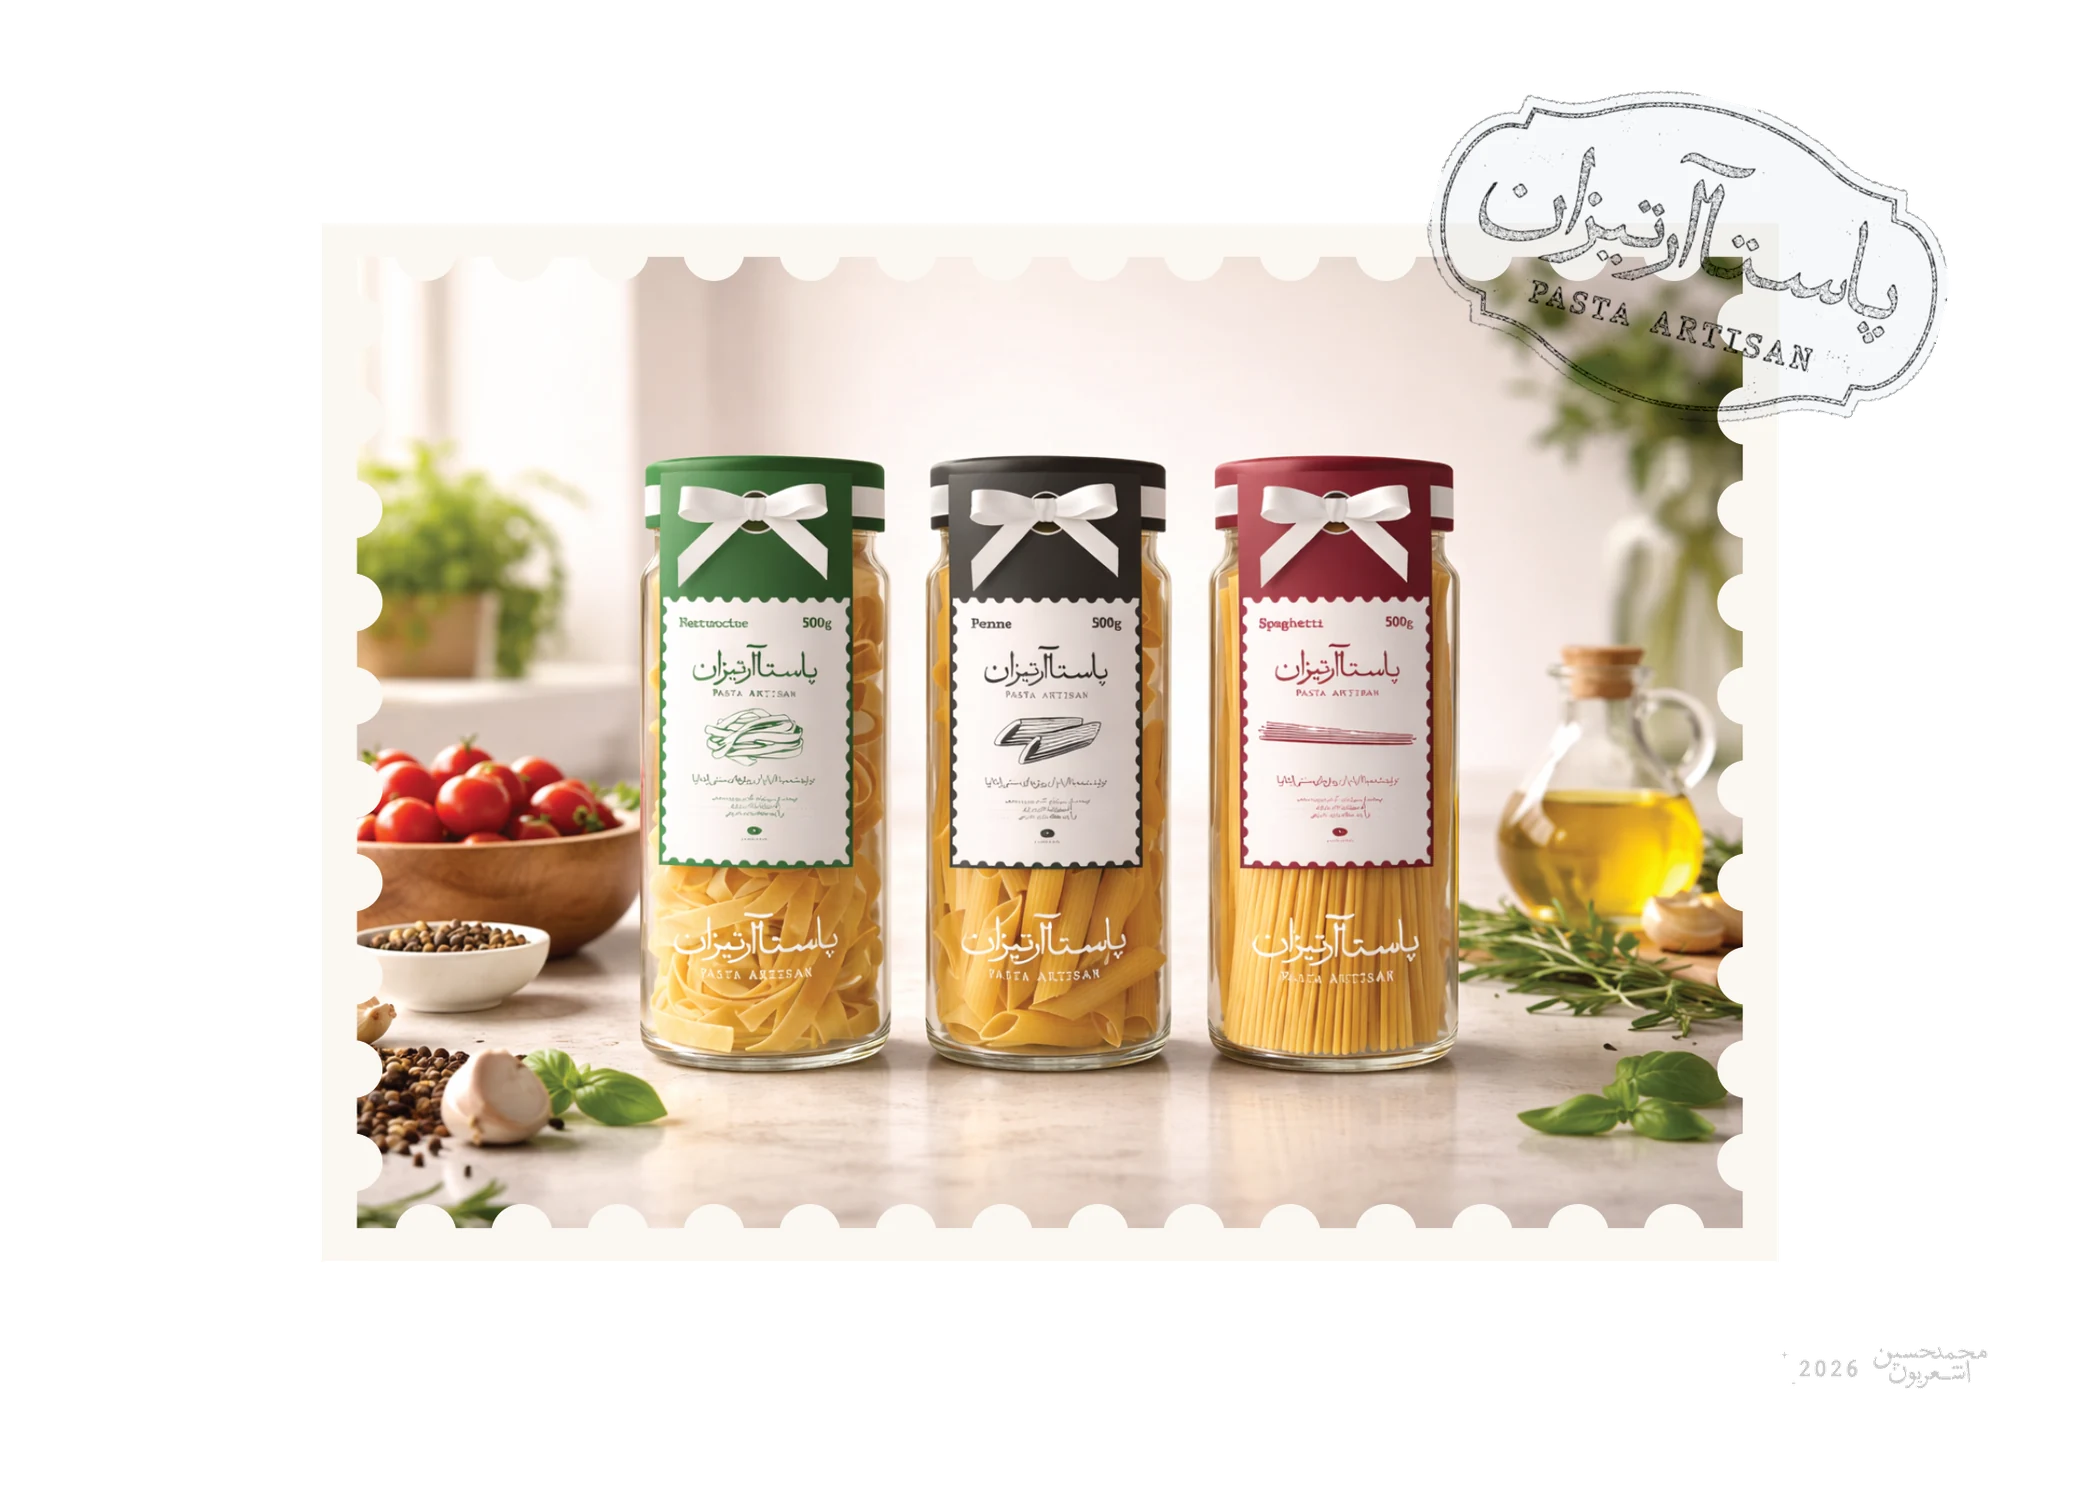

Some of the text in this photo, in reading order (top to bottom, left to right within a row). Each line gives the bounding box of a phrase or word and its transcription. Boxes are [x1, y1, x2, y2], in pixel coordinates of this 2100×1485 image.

[802, 616, 833, 632] 500g
[970, 617, 1013, 630] Penne
[1091, 616, 1123, 632] 500g
[1258, 617, 1325, 632] Spaghetti
[1384, 615, 1415, 631] 500g
[712, 688, 744, 698] PASTA
[1005, 690, 1037, 700] PASTA
[1295, 688, 1327, 698] PASTA
